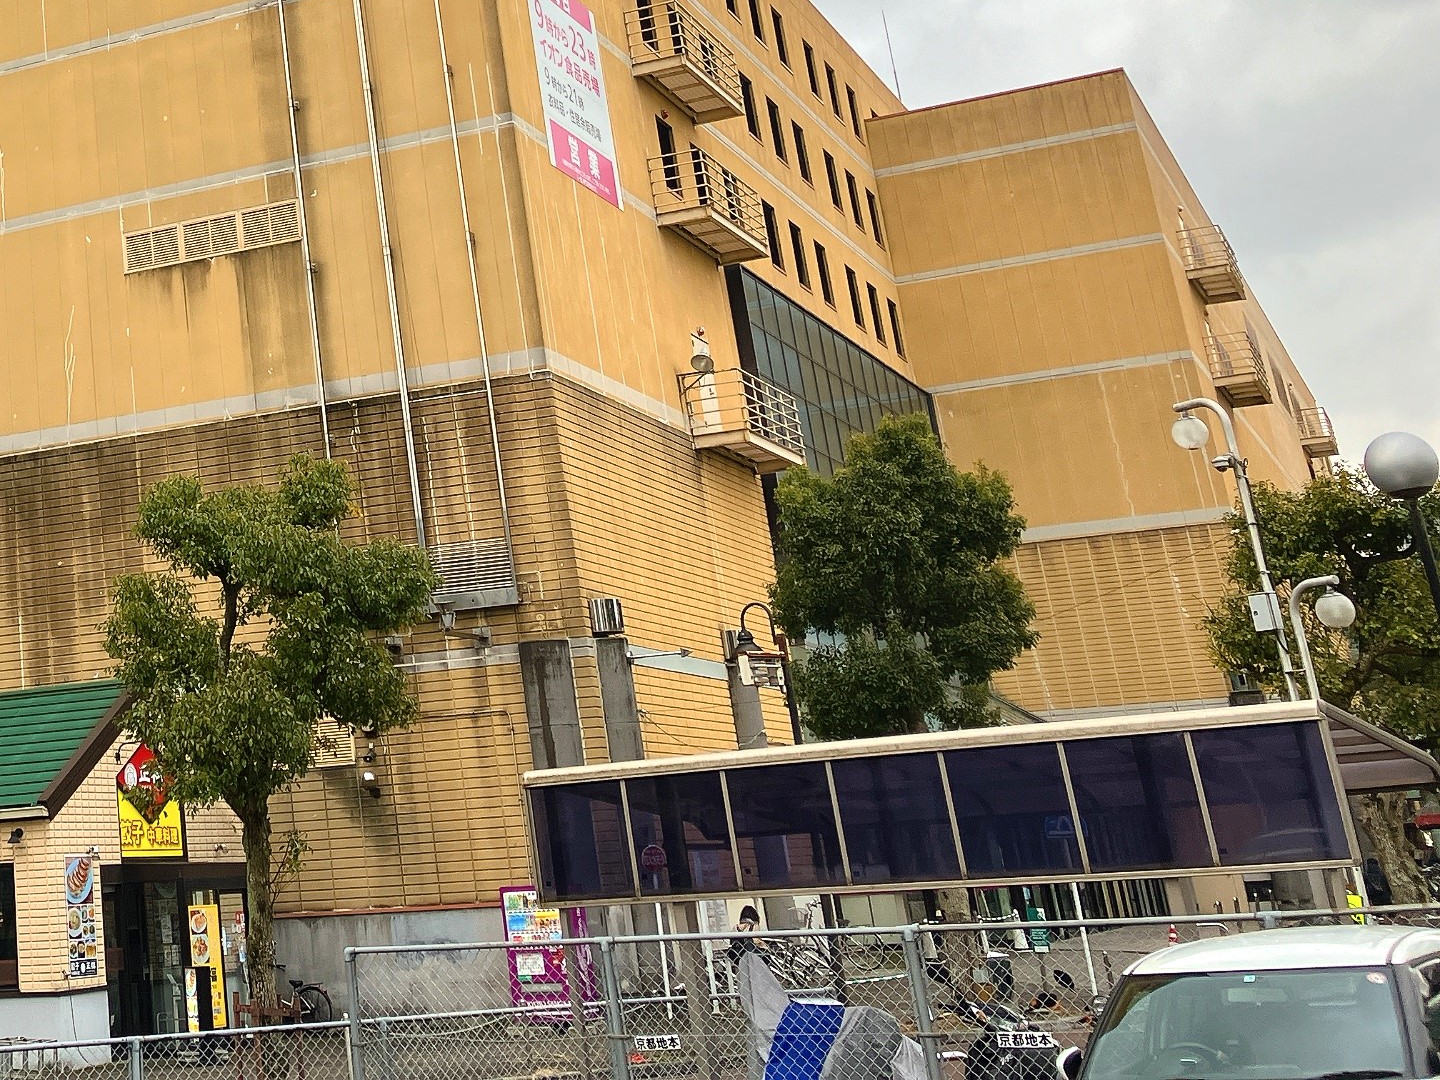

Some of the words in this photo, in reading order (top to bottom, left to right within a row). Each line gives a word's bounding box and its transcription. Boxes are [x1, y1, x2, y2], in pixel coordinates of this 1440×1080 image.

[540, 39, 600, 97] イオン食品売場
[636, 1036, 679, 1050] 京都地本
[998, 1033, 1052, 1047] 京都地本
